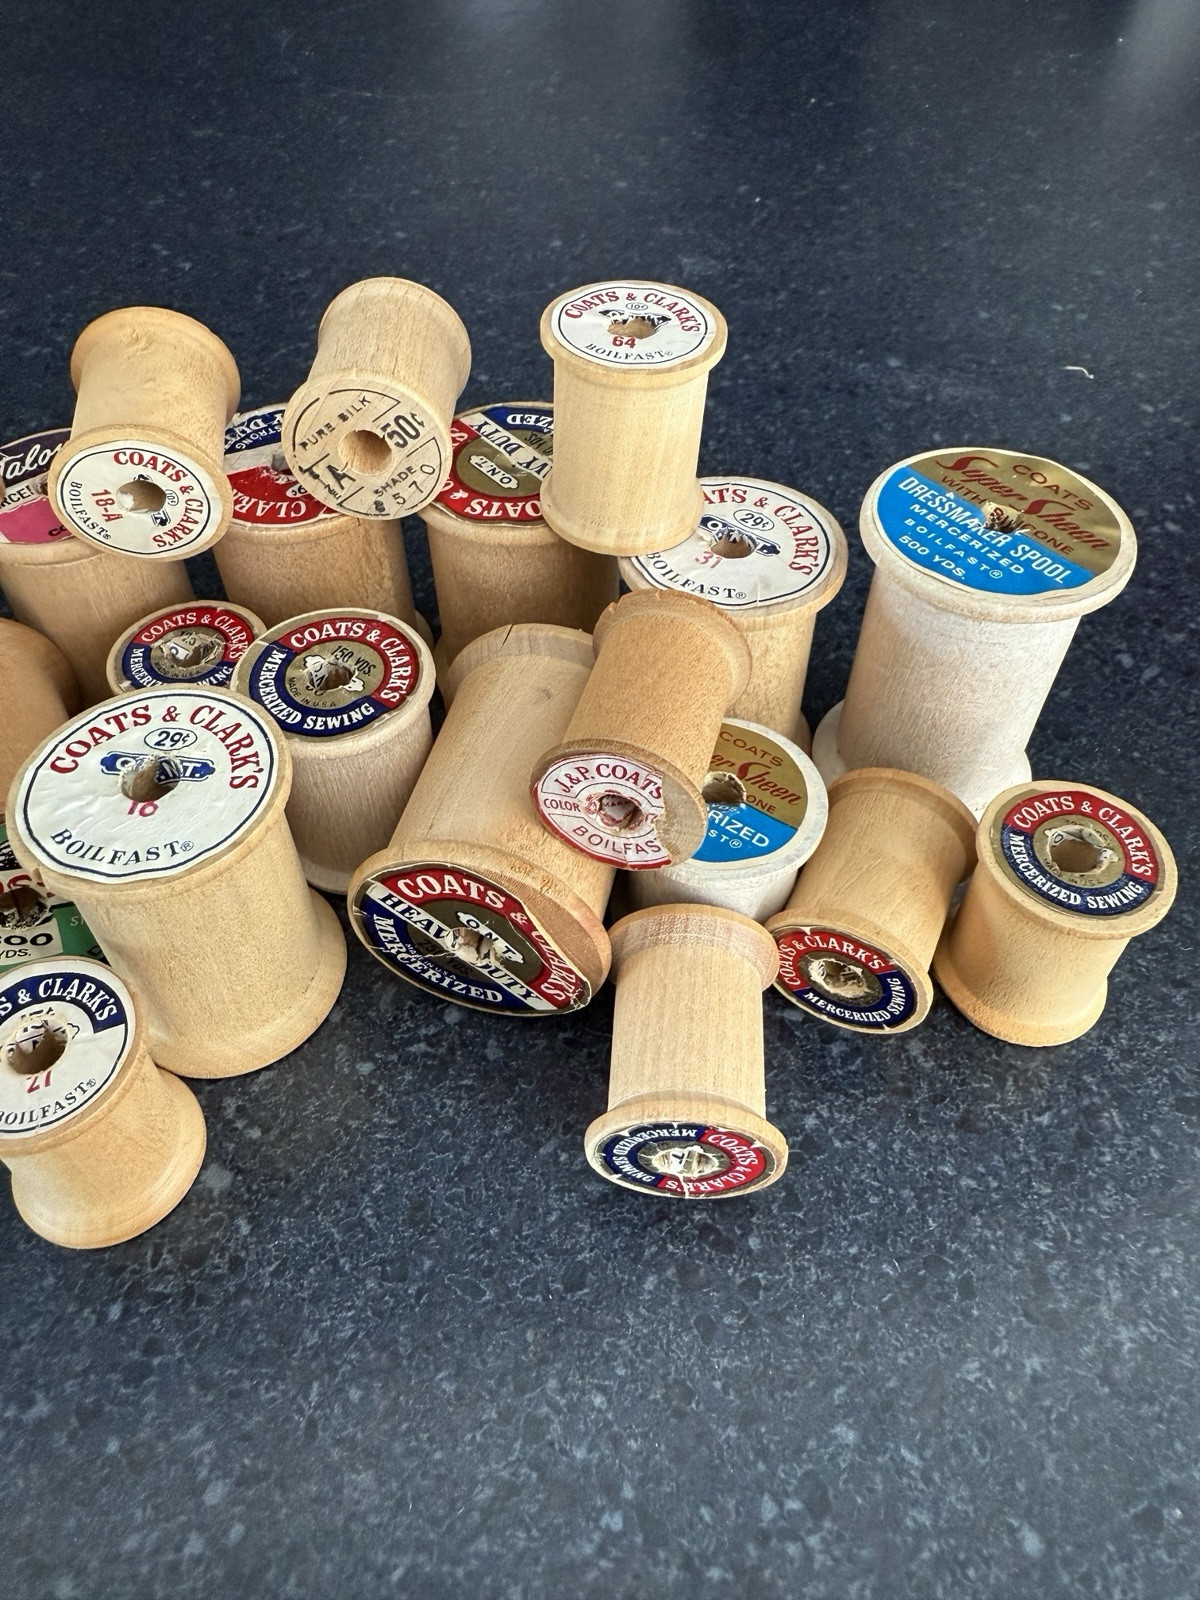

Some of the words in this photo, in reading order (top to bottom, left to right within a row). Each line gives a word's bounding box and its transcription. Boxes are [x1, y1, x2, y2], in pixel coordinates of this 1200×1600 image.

[564, 290, 620, 319] COATS
[625, 292, 637, 301] &
[643, 292, 702, 332] CLARK'S
[612, 336, 636, 349] 64
[235, 424, 282, 450] STRONG
[299, 423, 336, 450] PURE
[338, 396, 371, 422] SILK
[380, 412, 425, 448] 50¢
[469, 420, 525, 457] DUTY
[0, 443, 63, 480] Talo
[113, 451, 189, 483] COATS
[326, 464, 356, 490] A
[179, 484, 195, 495] &
[373, 465, 417, 497] SHADE
[449, 488, 469, 500] &
[941, 476, 987, 505] WITH
[1012, 464, 1095, 511] COATS
[91, 489, 124, 523] 18-A
[464, 498, 543, 518] OATS
[739, 513, 770, 529] 29¢
[935, 456, 1028, 501] Super
[1008, 498, 1111, 550] Sheen
[152, 499, 204, 548] CLARK'S
[703, 488, 748, 505] ATS
[754, 496, 770, 508] &
[774, 505, 820, 576] CLARK'S
[898, 477, 1013, 547] DRESSMAKER
[1010, 544, 1073, 585] SPOOL
[910, 504, 1025, 575] MERCERIZED
[695, 550, 723, 569] 31
[898, 535, 929, 556] 500
[932, 554, 966, 580] YDS.
[141, 612, 197, 643] COATS
[200, 613, 212, 624] &
[196, 665, 233, 687] WING
[290, 622, 367, 648] COATS
[366, 629, 381, 642] &
[380, 638, 412, 703] CLARK'S
[331, 645, 352, 663] 150
[355, 656, 376, 677] YDS.
[258, 650, 303, 725] MERCERIZED
[302, 702, 375, 731] SEWING
[288, 676, 301, 698] MADE
[301, 696, 311, 705] IN
[50, 704, 153, 775] COATS
[161, 705, 181, 723] &
[189, 704, 265, 790] CLARK'S
[153, 730, 191, 748] 29¢
[719, 731, 784, 767] COATS
[595, 763, 663, 800] COATS
[736, 761, 802, 806] Sheen
[543, 798, 582, 813] COLOR
[572, 825, 662, 856] BOILFAS
[707, 809, 770, 848] RIZED
[1013, 796, 1076, 829] COATS
[1080, 800, 1094, 814] &
[1098, 807, 1153, 877] CLARK'S
[1009, 832, 1081, 906] MERCERIZED
[1086, 881, 1144, 910] SEWING
[378, 892, 447, 939] HEAV
[397, 874, 507, 909] COATS
[509, 911, 528, 926] &
[373, 914, 504, 1003] MERCERIZED
[779, 944, 801, 986] COATS
[791, 939, 807, 951] &
[804, 935, 885, 969] CLARK'S
[17, 988, 33, 1005] &
[38, 977, 118, 1021] CLARK'S
[803, 992, 891, 1022] MERCERIZED
[886, 978, 906, 1015] SEWING
[612, 1129, 698, 1156] MERCERIZED
[707, 1134, 759, 1166] COATS
[612, 1156, 654, 1182] SEWING
